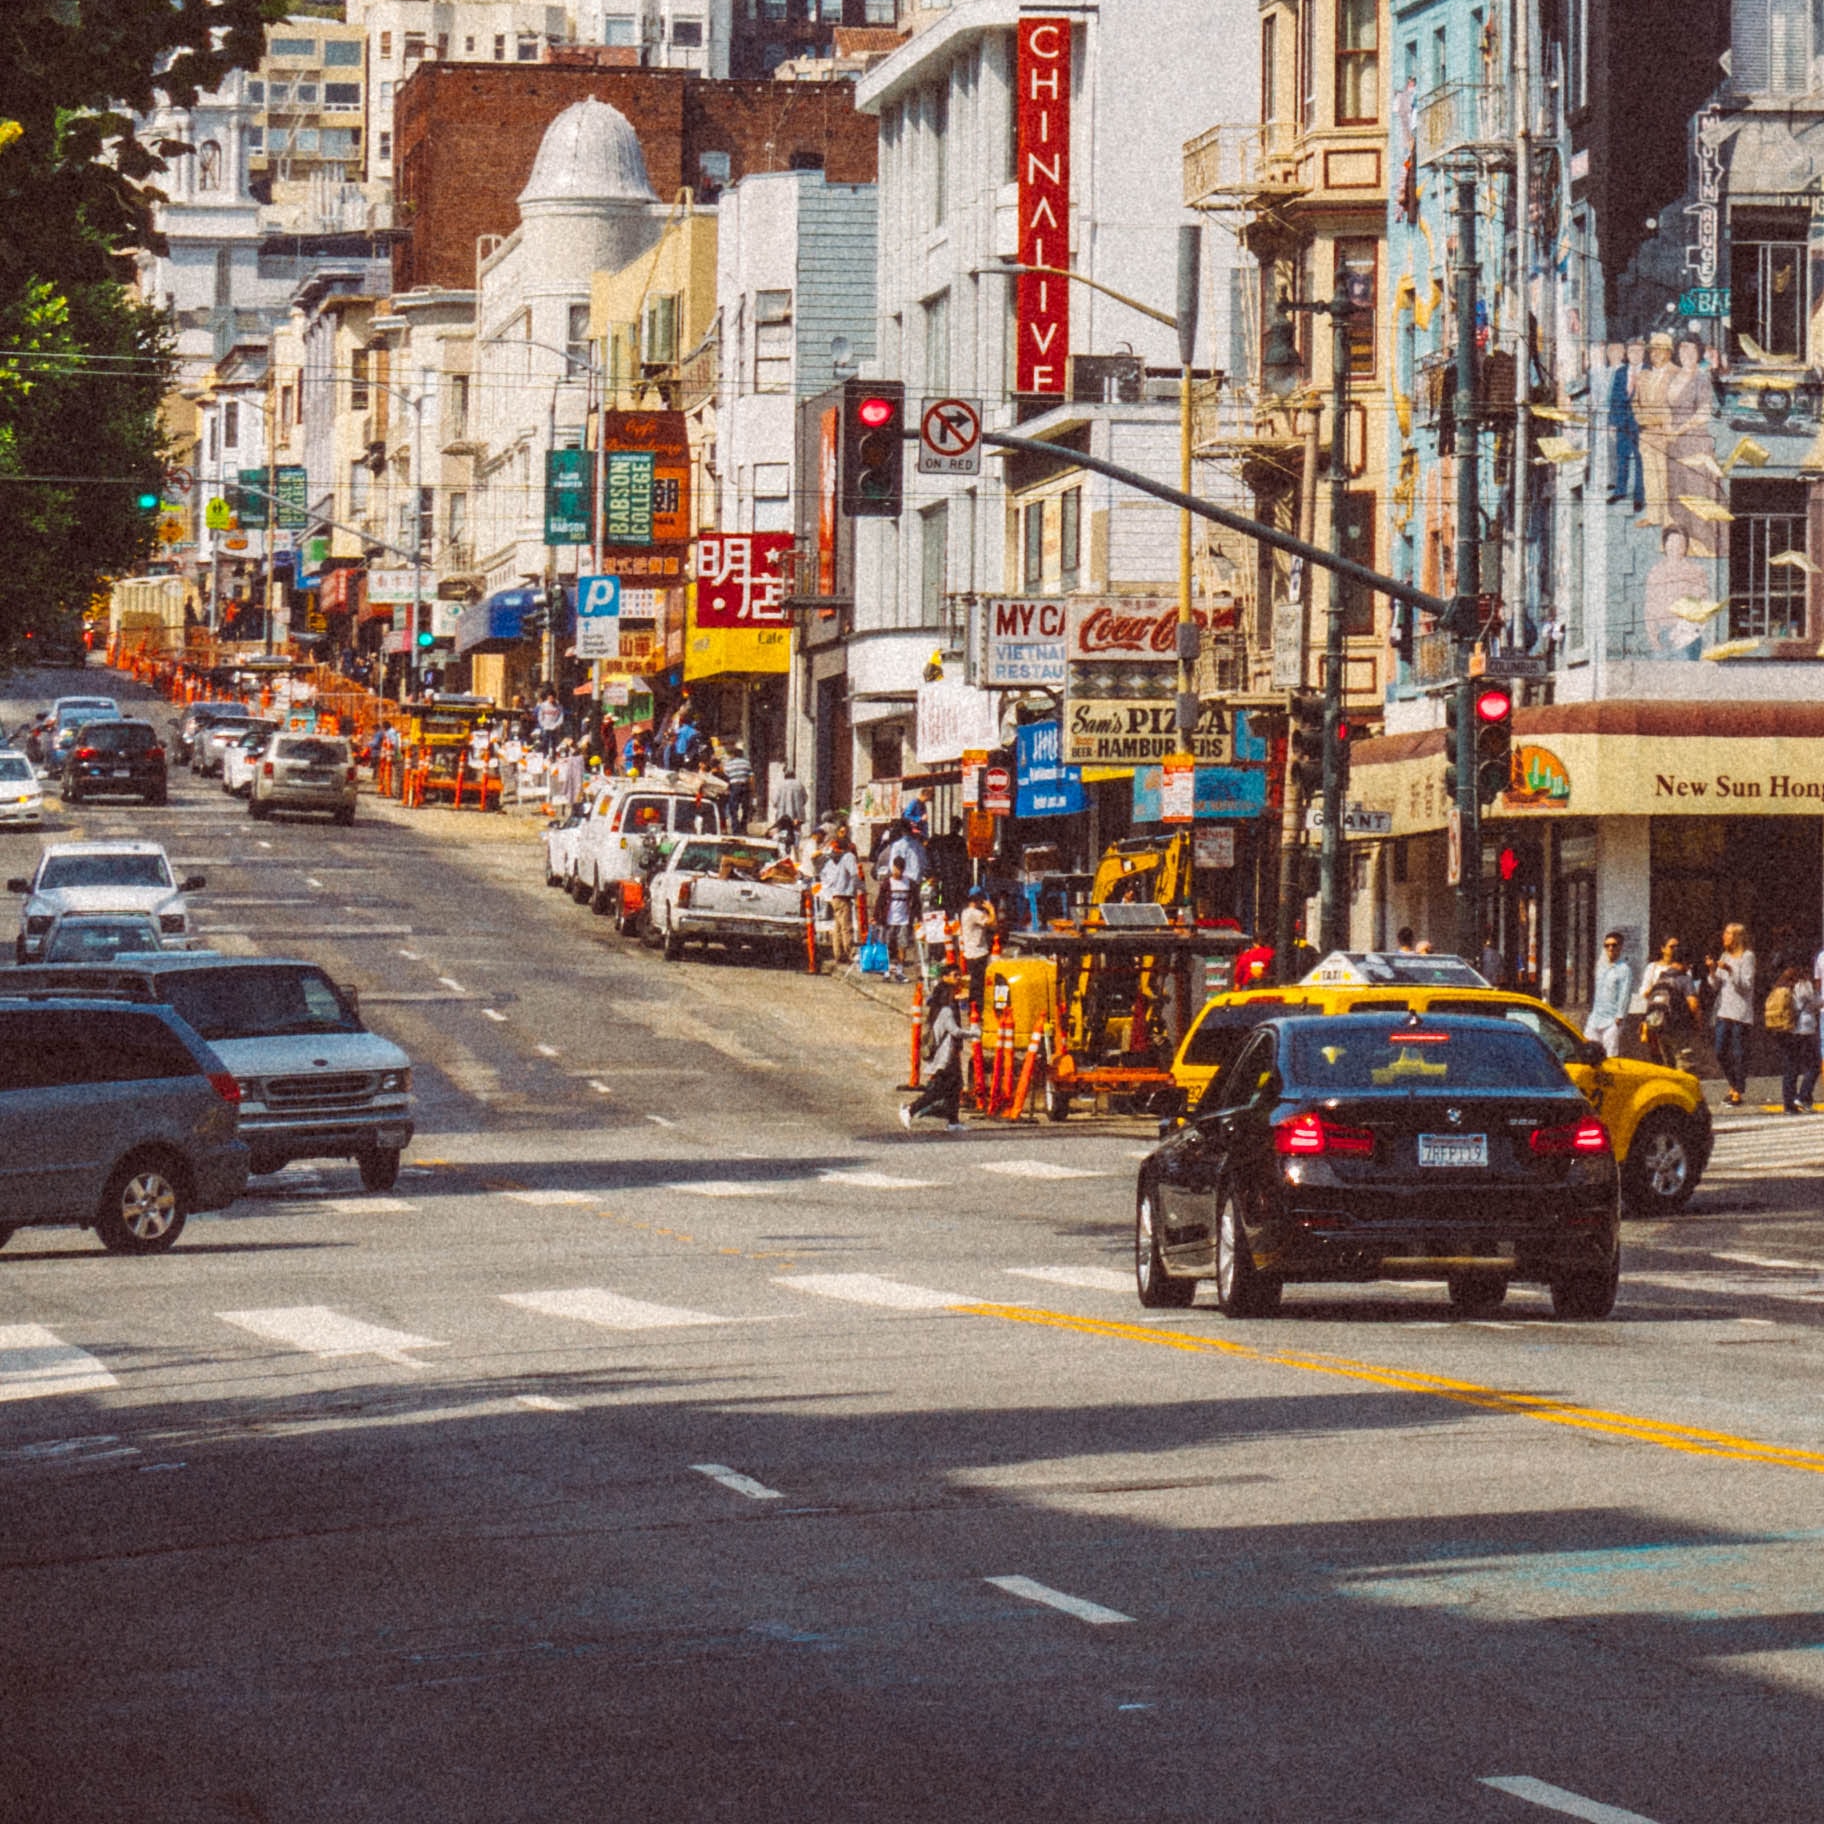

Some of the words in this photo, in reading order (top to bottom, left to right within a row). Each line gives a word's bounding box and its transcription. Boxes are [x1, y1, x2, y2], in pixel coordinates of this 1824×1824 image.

[926, 457, 946, 470] ON
[950, 457, 975, 472] RED
[609, 461, 631, 535] BABSON
[630, 461, 651, 535] COLLEGE
[698, 537, 751, 618] 明
[996, 603, 1034, 636] MY
[1071, 704, 1122, 735] Sam's
[1099, 738, 1223, 758] HAMBURERS
[1655, 774, 1710, 800] New
[1716, 775, 1762, 799] Sun
[1313, 812, 1386, 829] GANT
[1320, 969, 1343, 982] TAXI
